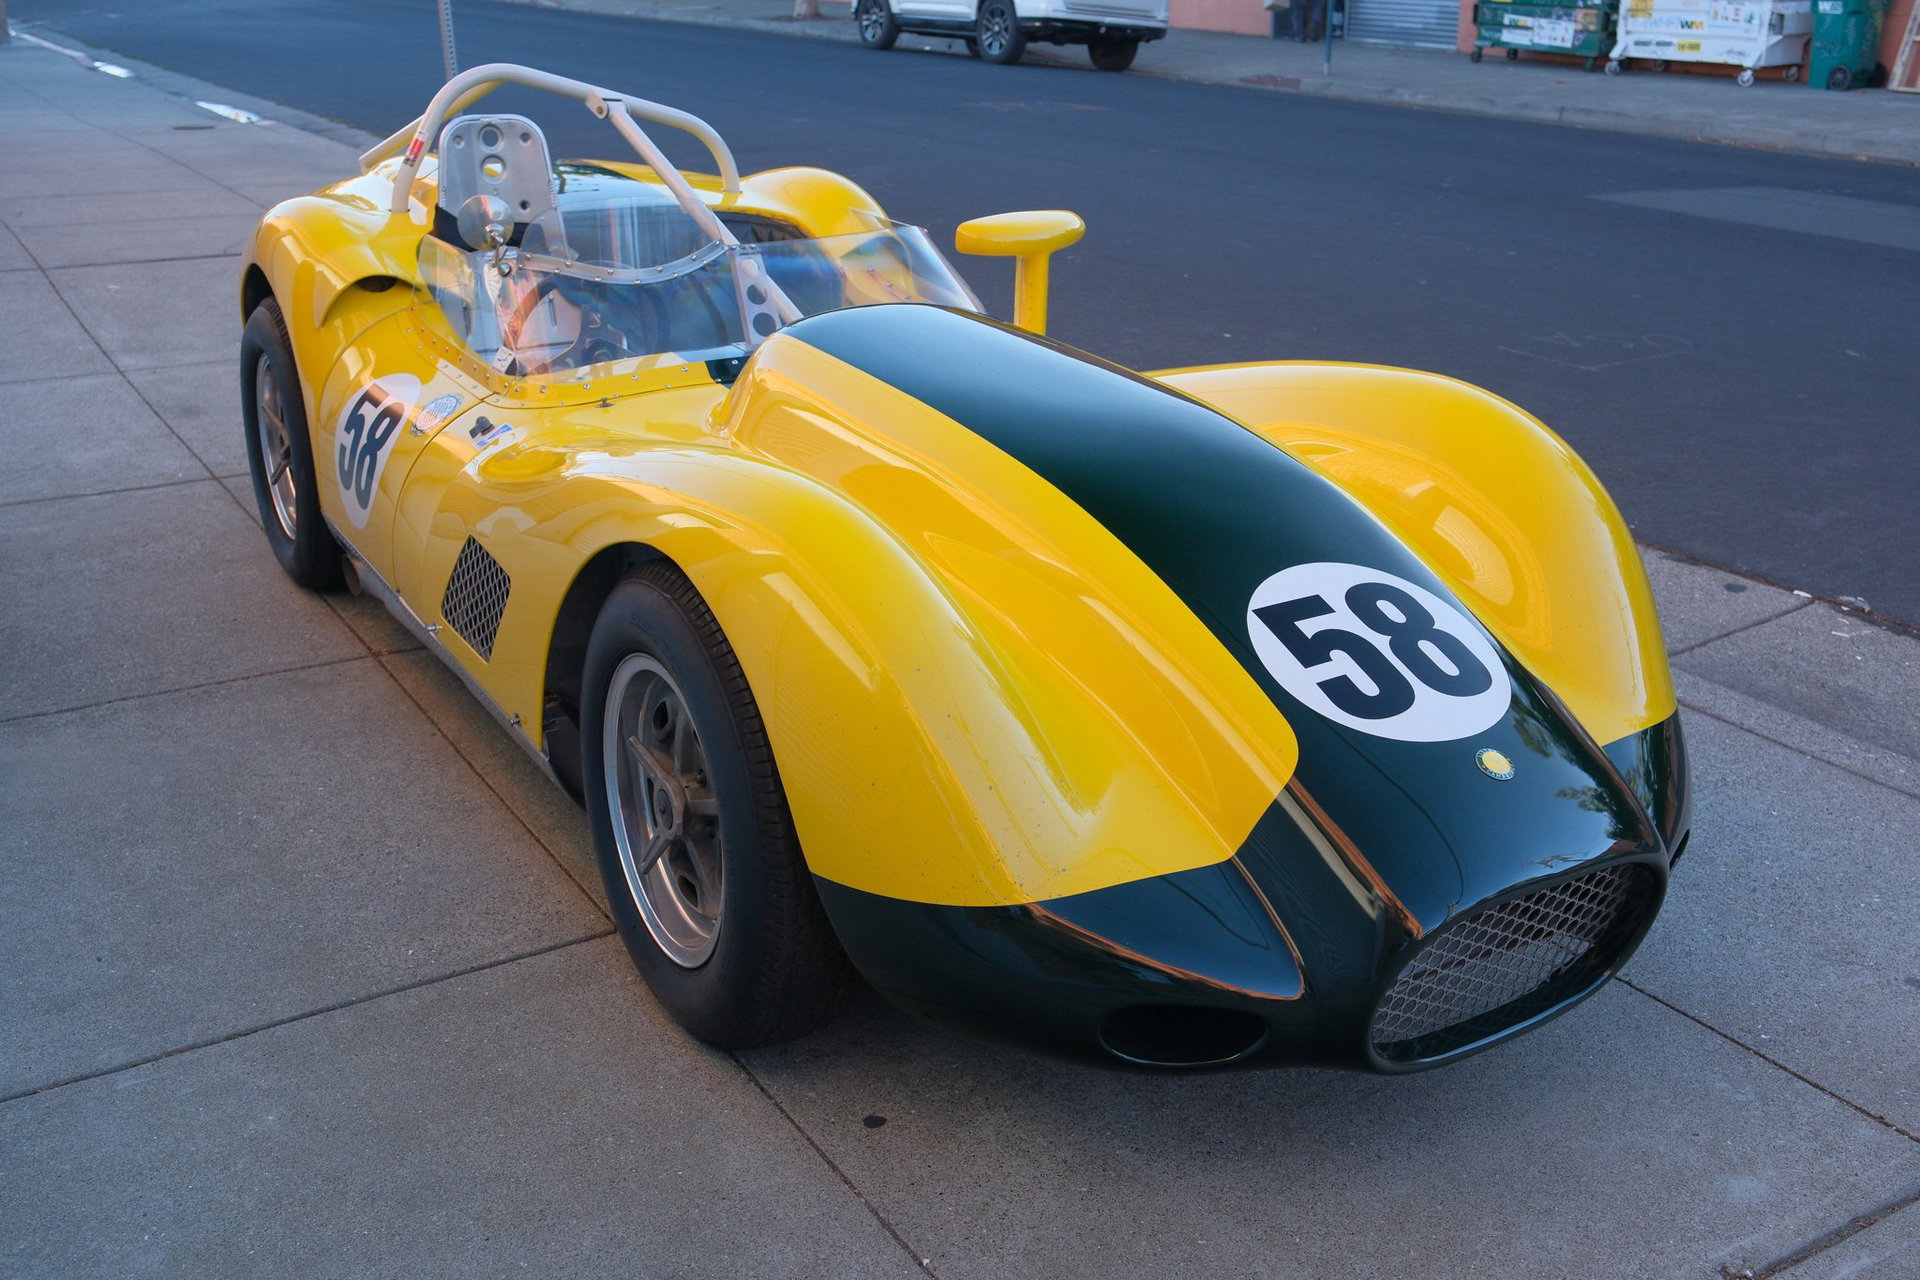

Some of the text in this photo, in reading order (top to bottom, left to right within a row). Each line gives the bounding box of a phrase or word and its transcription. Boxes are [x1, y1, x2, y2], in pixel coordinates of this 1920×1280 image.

[1680, 19, 1704, 30] WM
[339, 383, 405, 510] 58
[1252, 582, 1493, 720] 58
